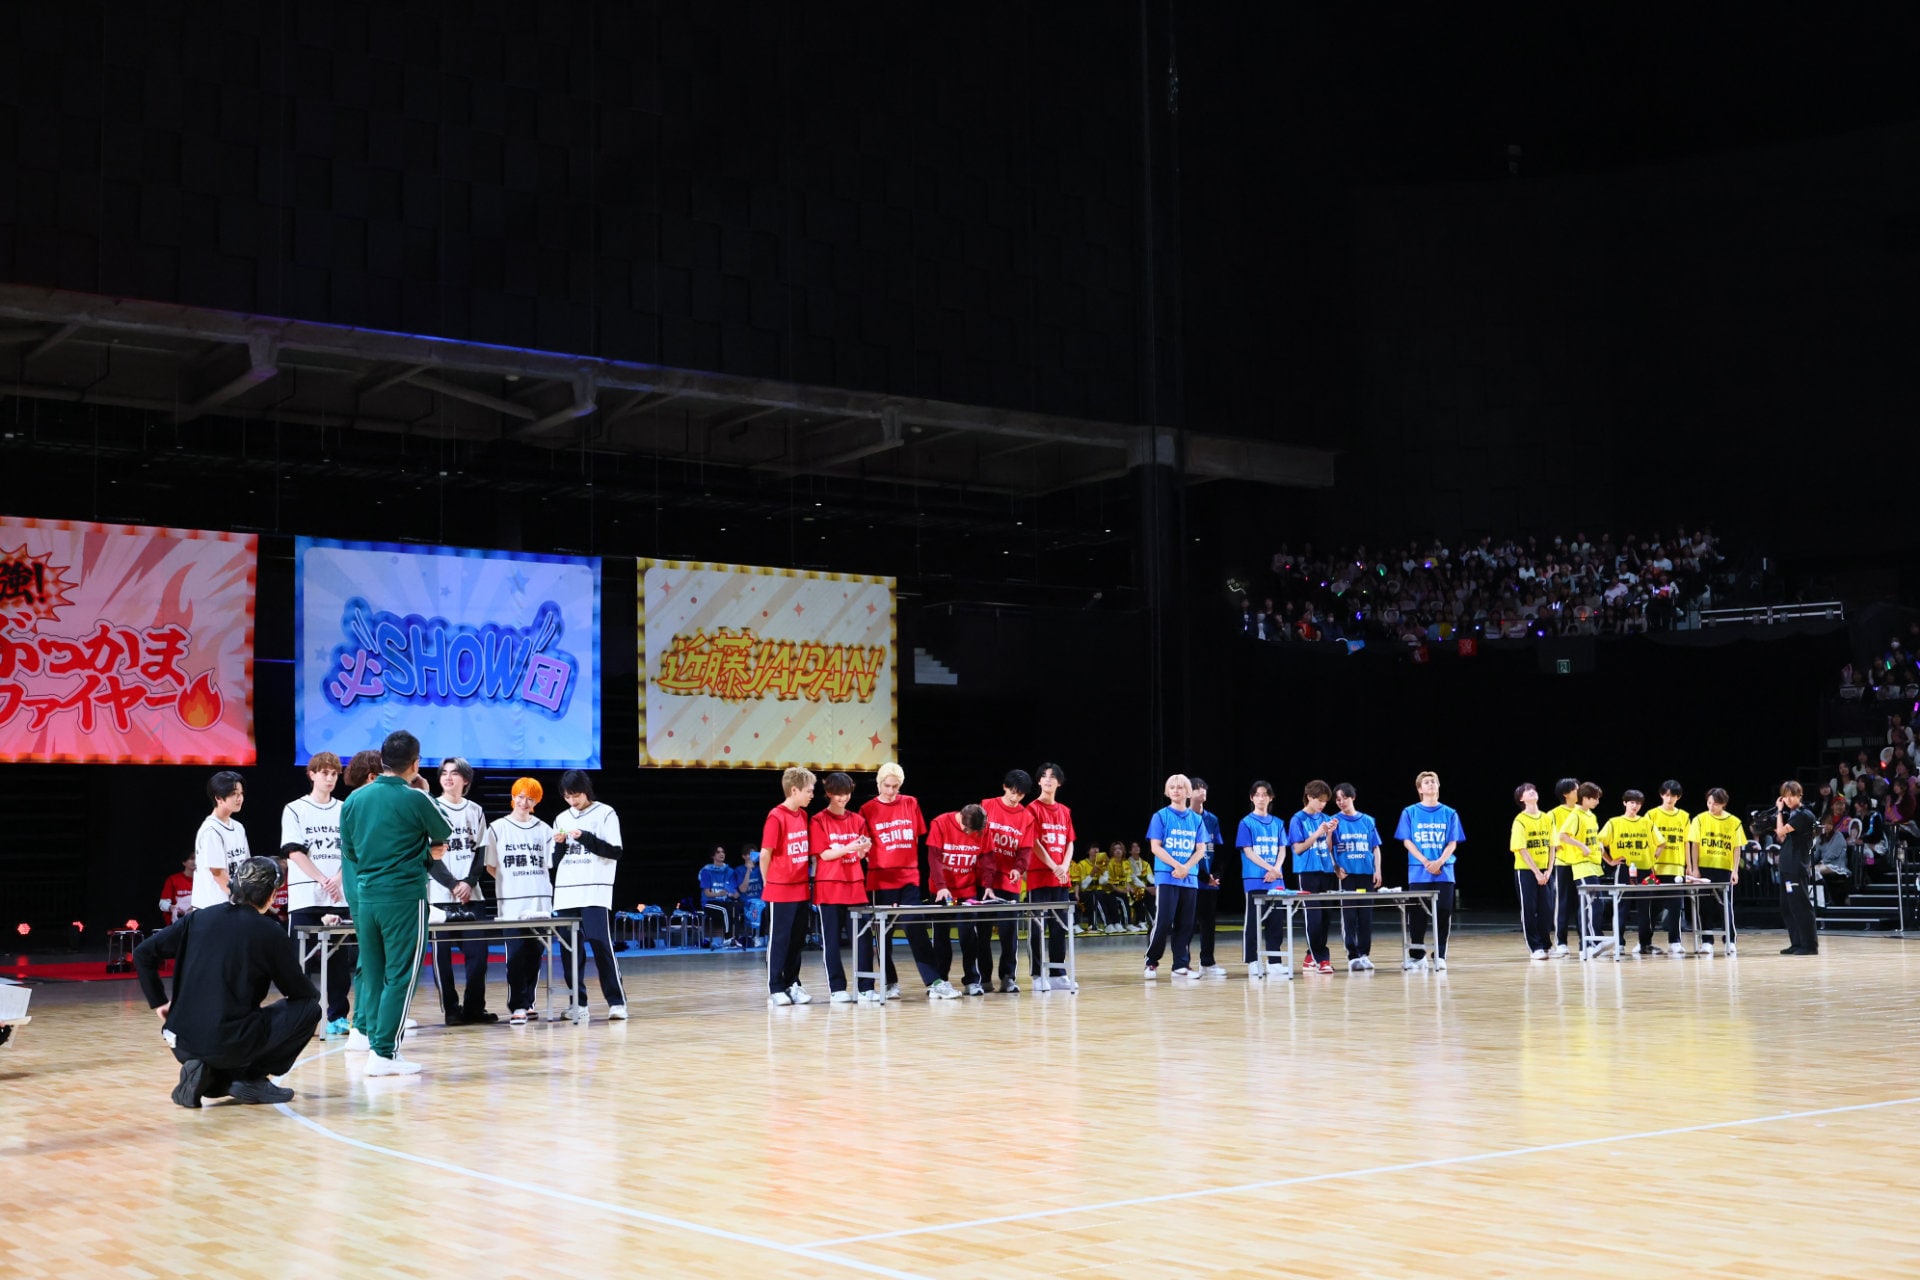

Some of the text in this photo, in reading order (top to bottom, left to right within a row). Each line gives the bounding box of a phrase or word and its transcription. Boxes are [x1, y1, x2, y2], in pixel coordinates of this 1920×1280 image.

[656, 632, 883, 699] 近藤JAPAN
[1616, 840, 1634, 849] 山本
[1701, 838, 1732, 851] FUMIYA
[503, 854, 528, 868] 伊藤
[942, 852, 977, 866] TETTA
